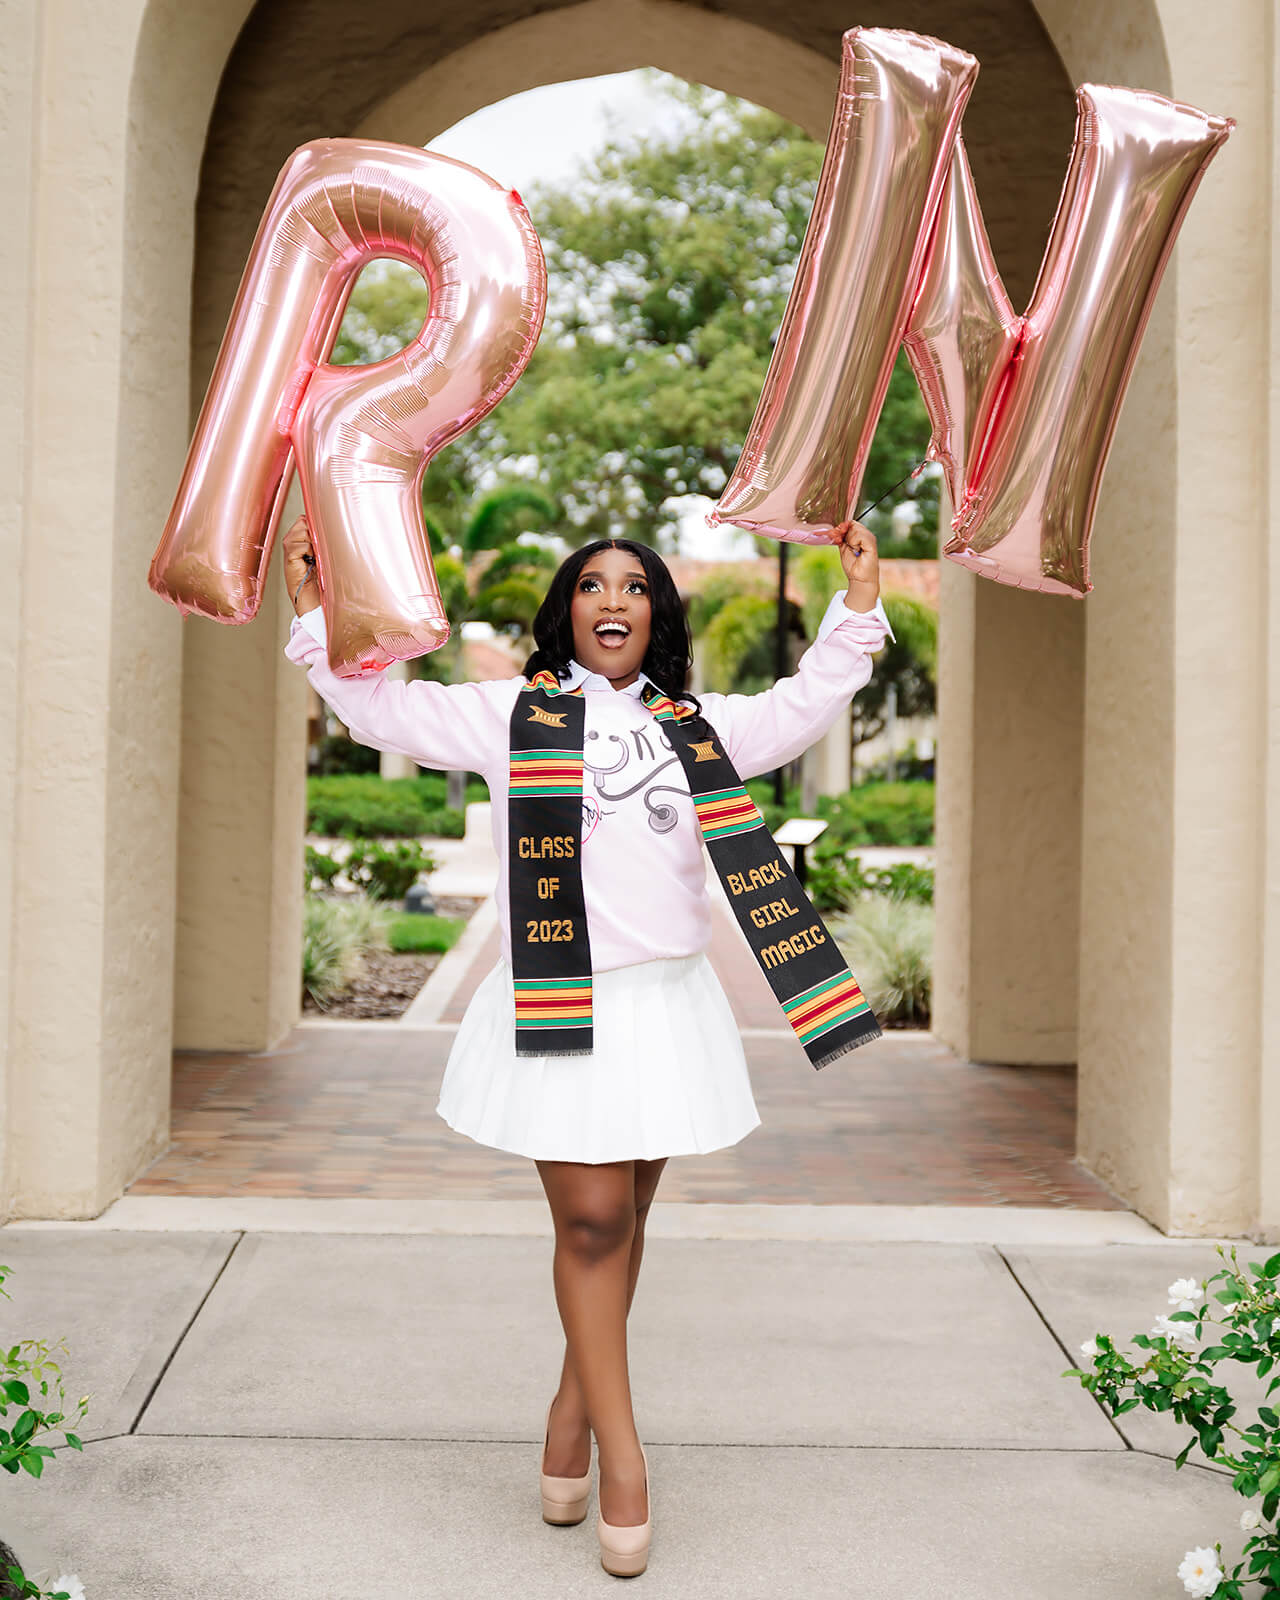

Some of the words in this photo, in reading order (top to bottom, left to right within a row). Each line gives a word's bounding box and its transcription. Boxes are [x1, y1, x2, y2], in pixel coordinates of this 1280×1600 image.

[148, 137, 547, 679] R
[705, 25, 1237, 599] N
[518, 836, 575, 859] CLASS
[537, 877, 560, 899] OF
[726, 859, 788, 896] BLACK
[750, 897, 800, 929] GIRL
[526, 919, 574, 943] 2023
[760, 925, 826, 970] MAGIC
